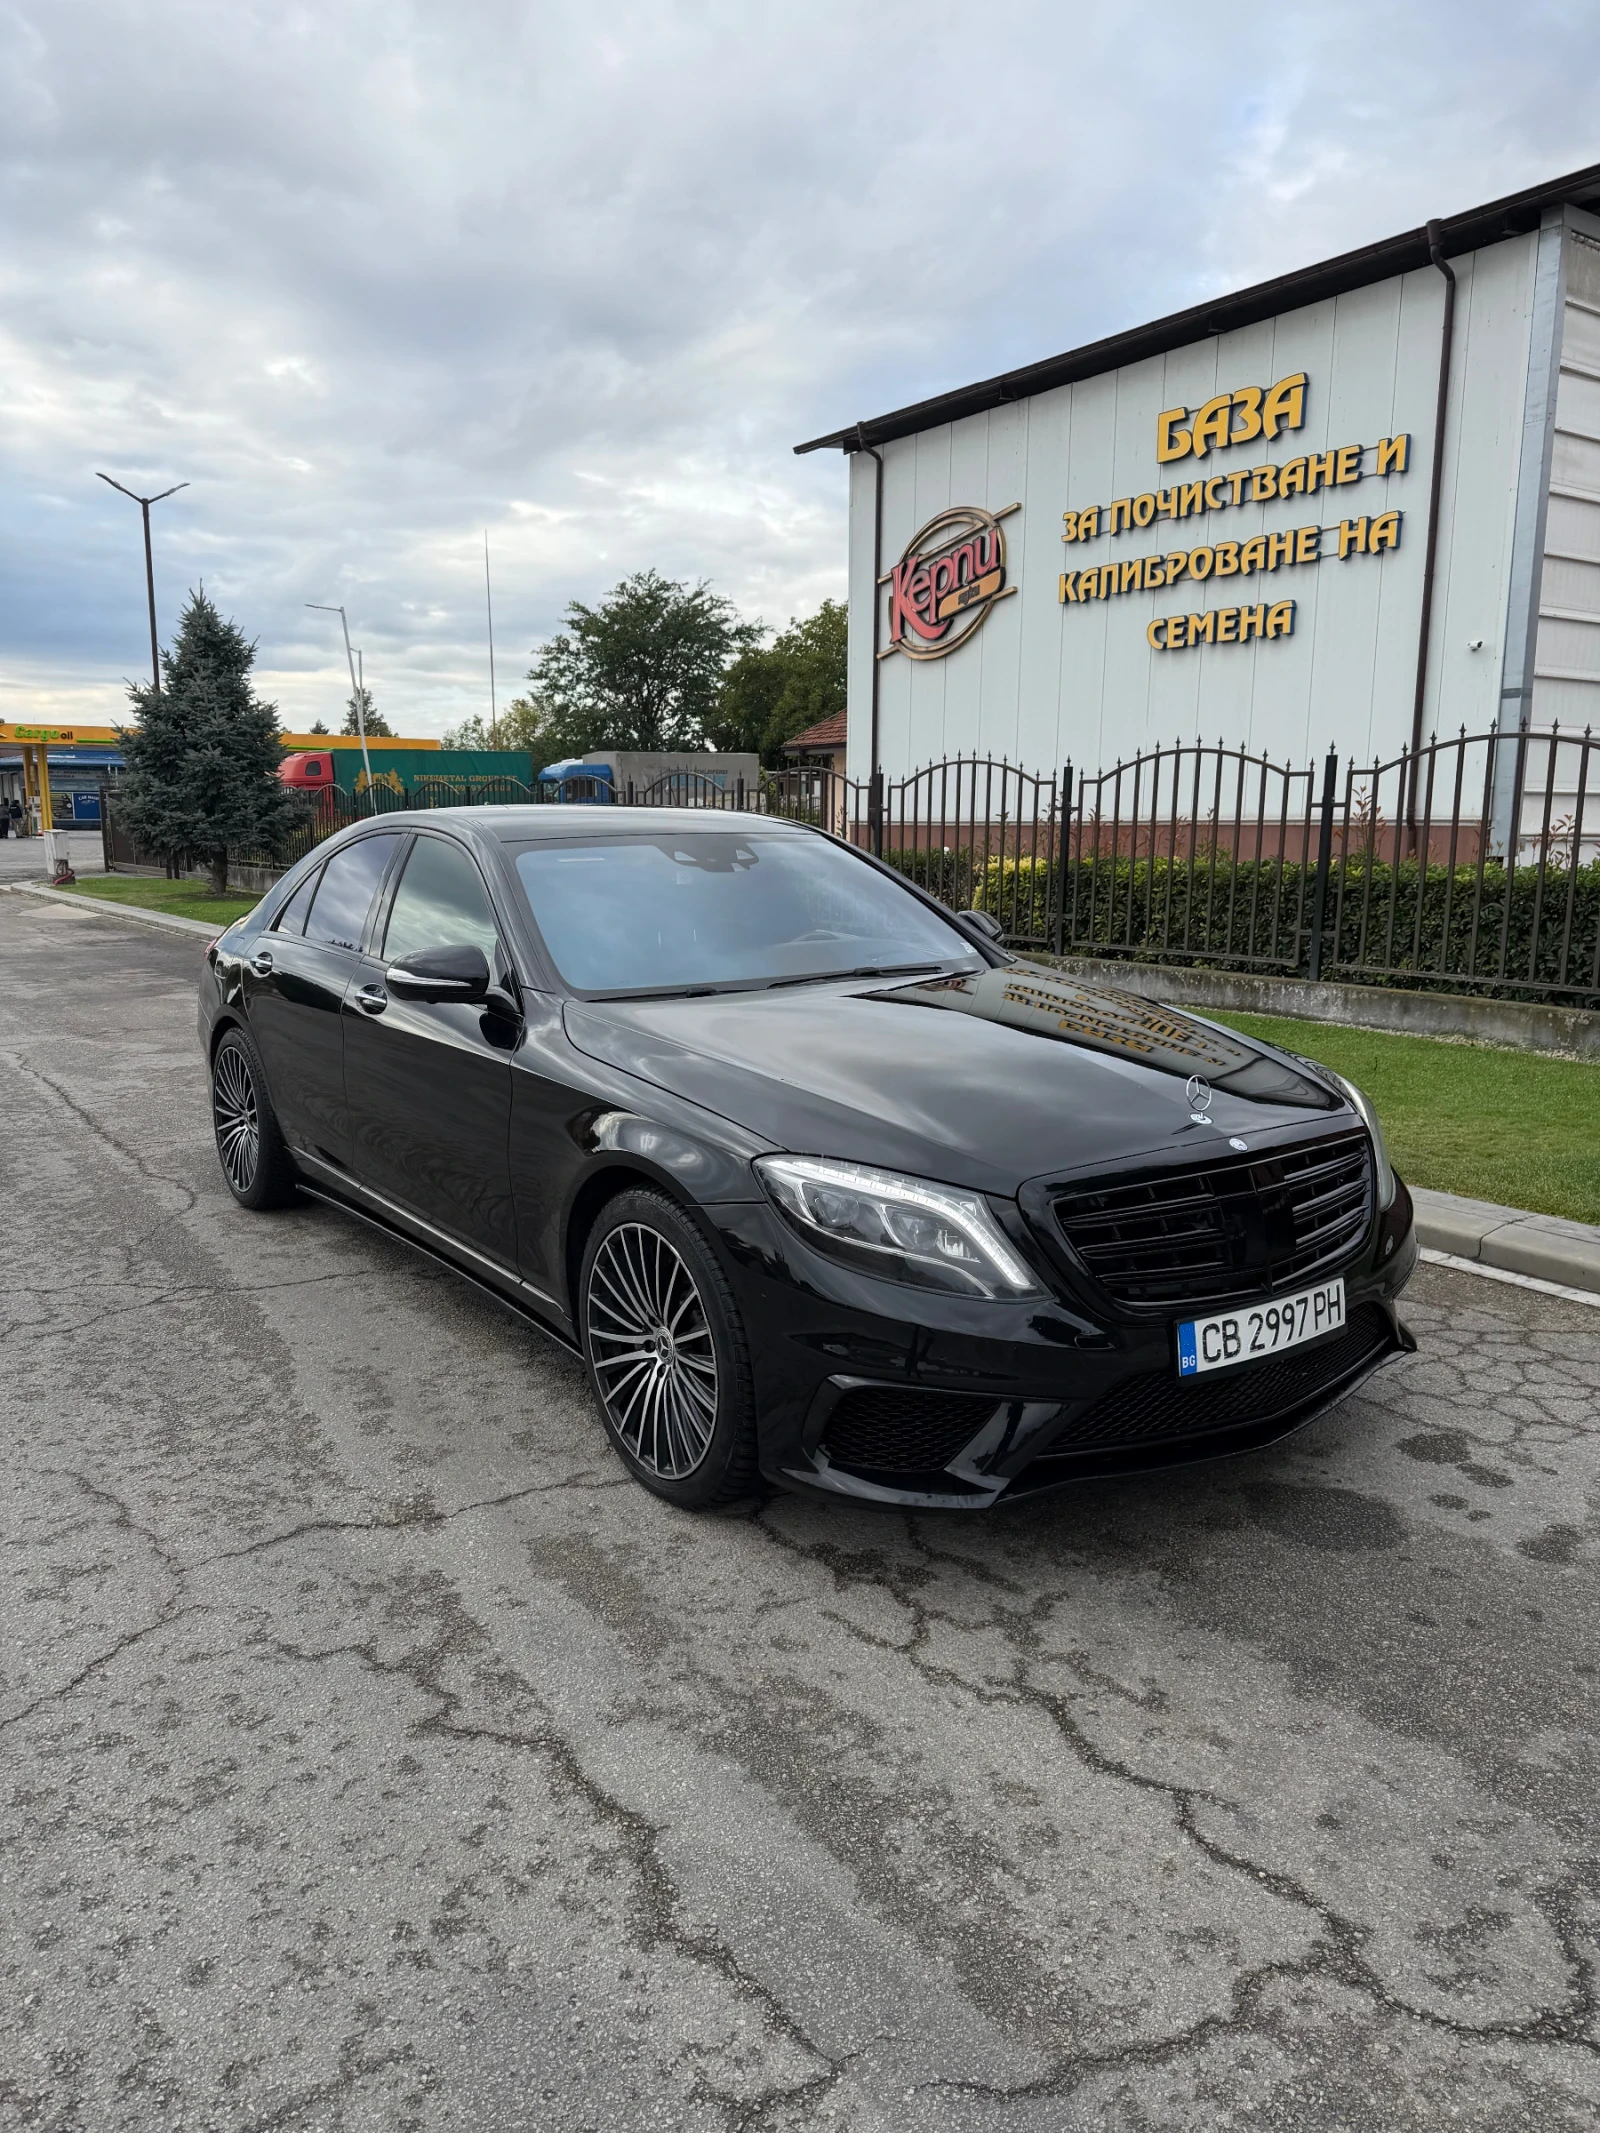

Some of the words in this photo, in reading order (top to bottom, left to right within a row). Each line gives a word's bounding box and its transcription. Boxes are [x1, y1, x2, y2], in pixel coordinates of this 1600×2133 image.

[1157, 372, 1309, 464] БАЗА
[1061, 505, 1102, 543] ЗА
[1110, 444, 1364, 537] ПОЧИСТВАНЕ
[1377, 433, 1411, 477] И
[1059, 525, 1321, 605] КАЛИБРОВАНЕ
[1339, 510, 1404, 561] НА
[1147, 600, 1297, 651] СЕМЕНА
[14, 725, 60, 742] Cargo
[60, 731, 73, 740] oil
[1181, 1355, 1196, 1369] BG
[1202, 1318, 1242, 1363] CB
[1247, 1296, 1309, 1353] 2997
[1313, 1284, 1342, 1332] PH
